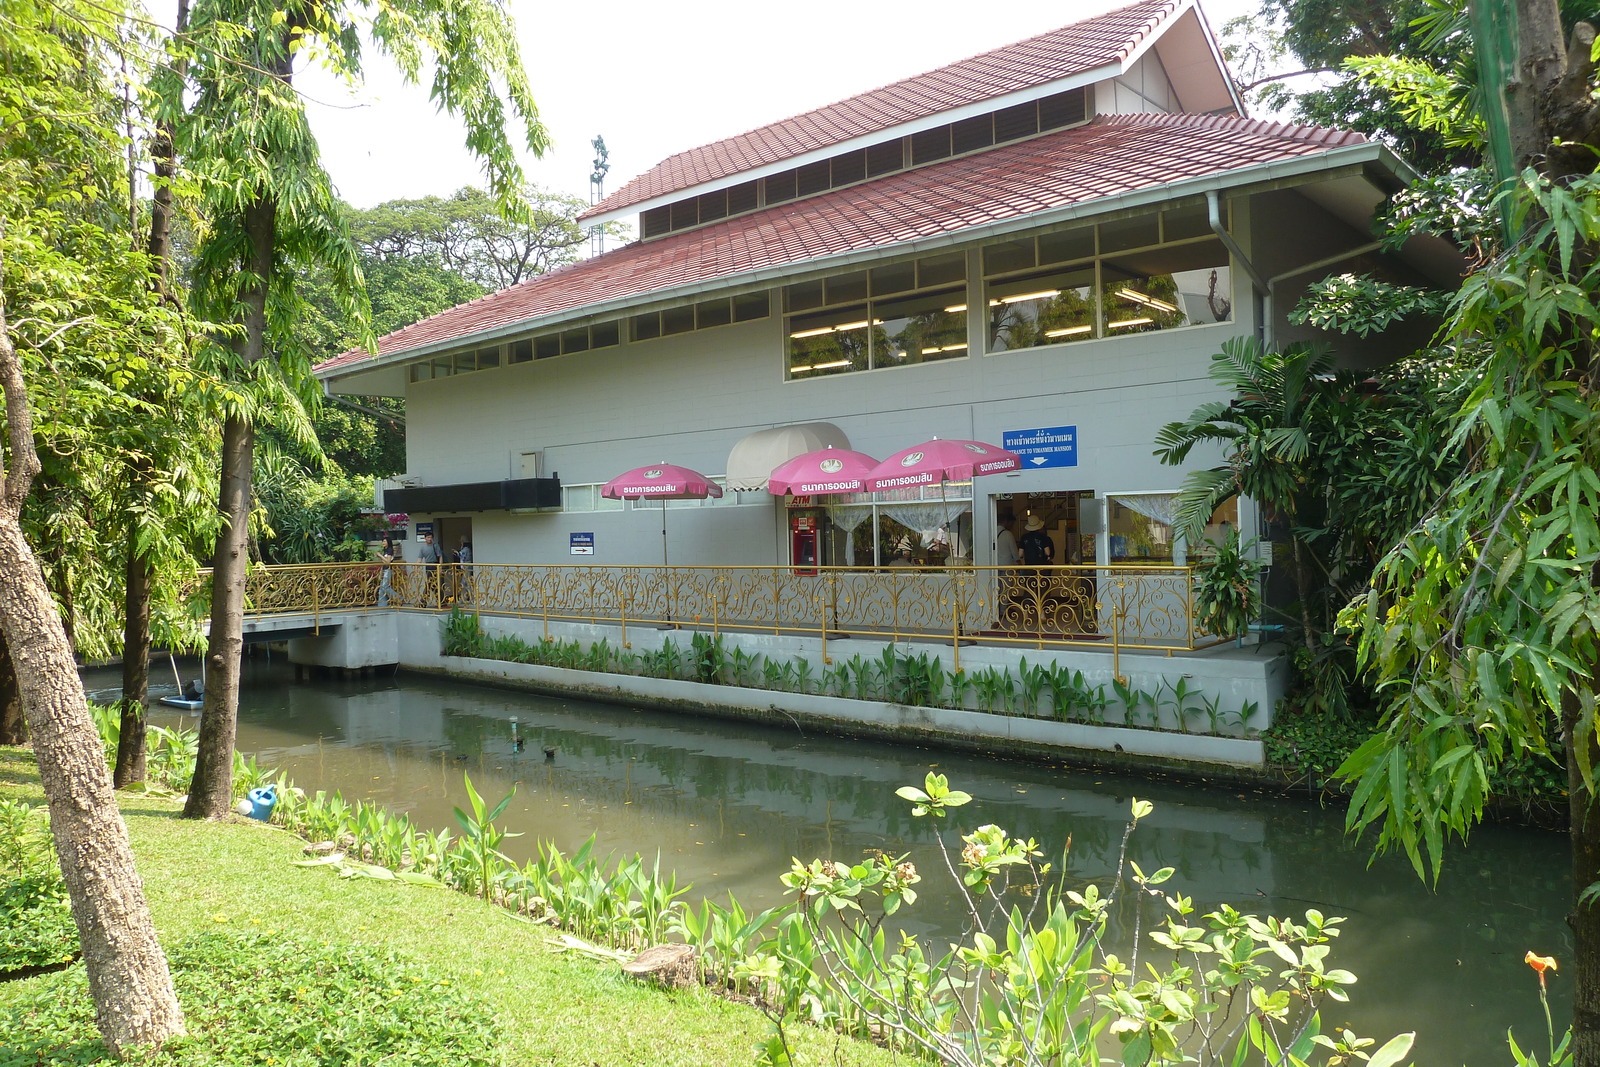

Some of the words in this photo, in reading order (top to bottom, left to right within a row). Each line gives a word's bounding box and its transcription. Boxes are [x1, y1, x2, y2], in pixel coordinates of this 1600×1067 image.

[876, 472, 933, 488] ธนาคารออมสิน
[623, 484, 677, 494] ธนาคารออมสิน
[791, 495, 811, 505] ATM
